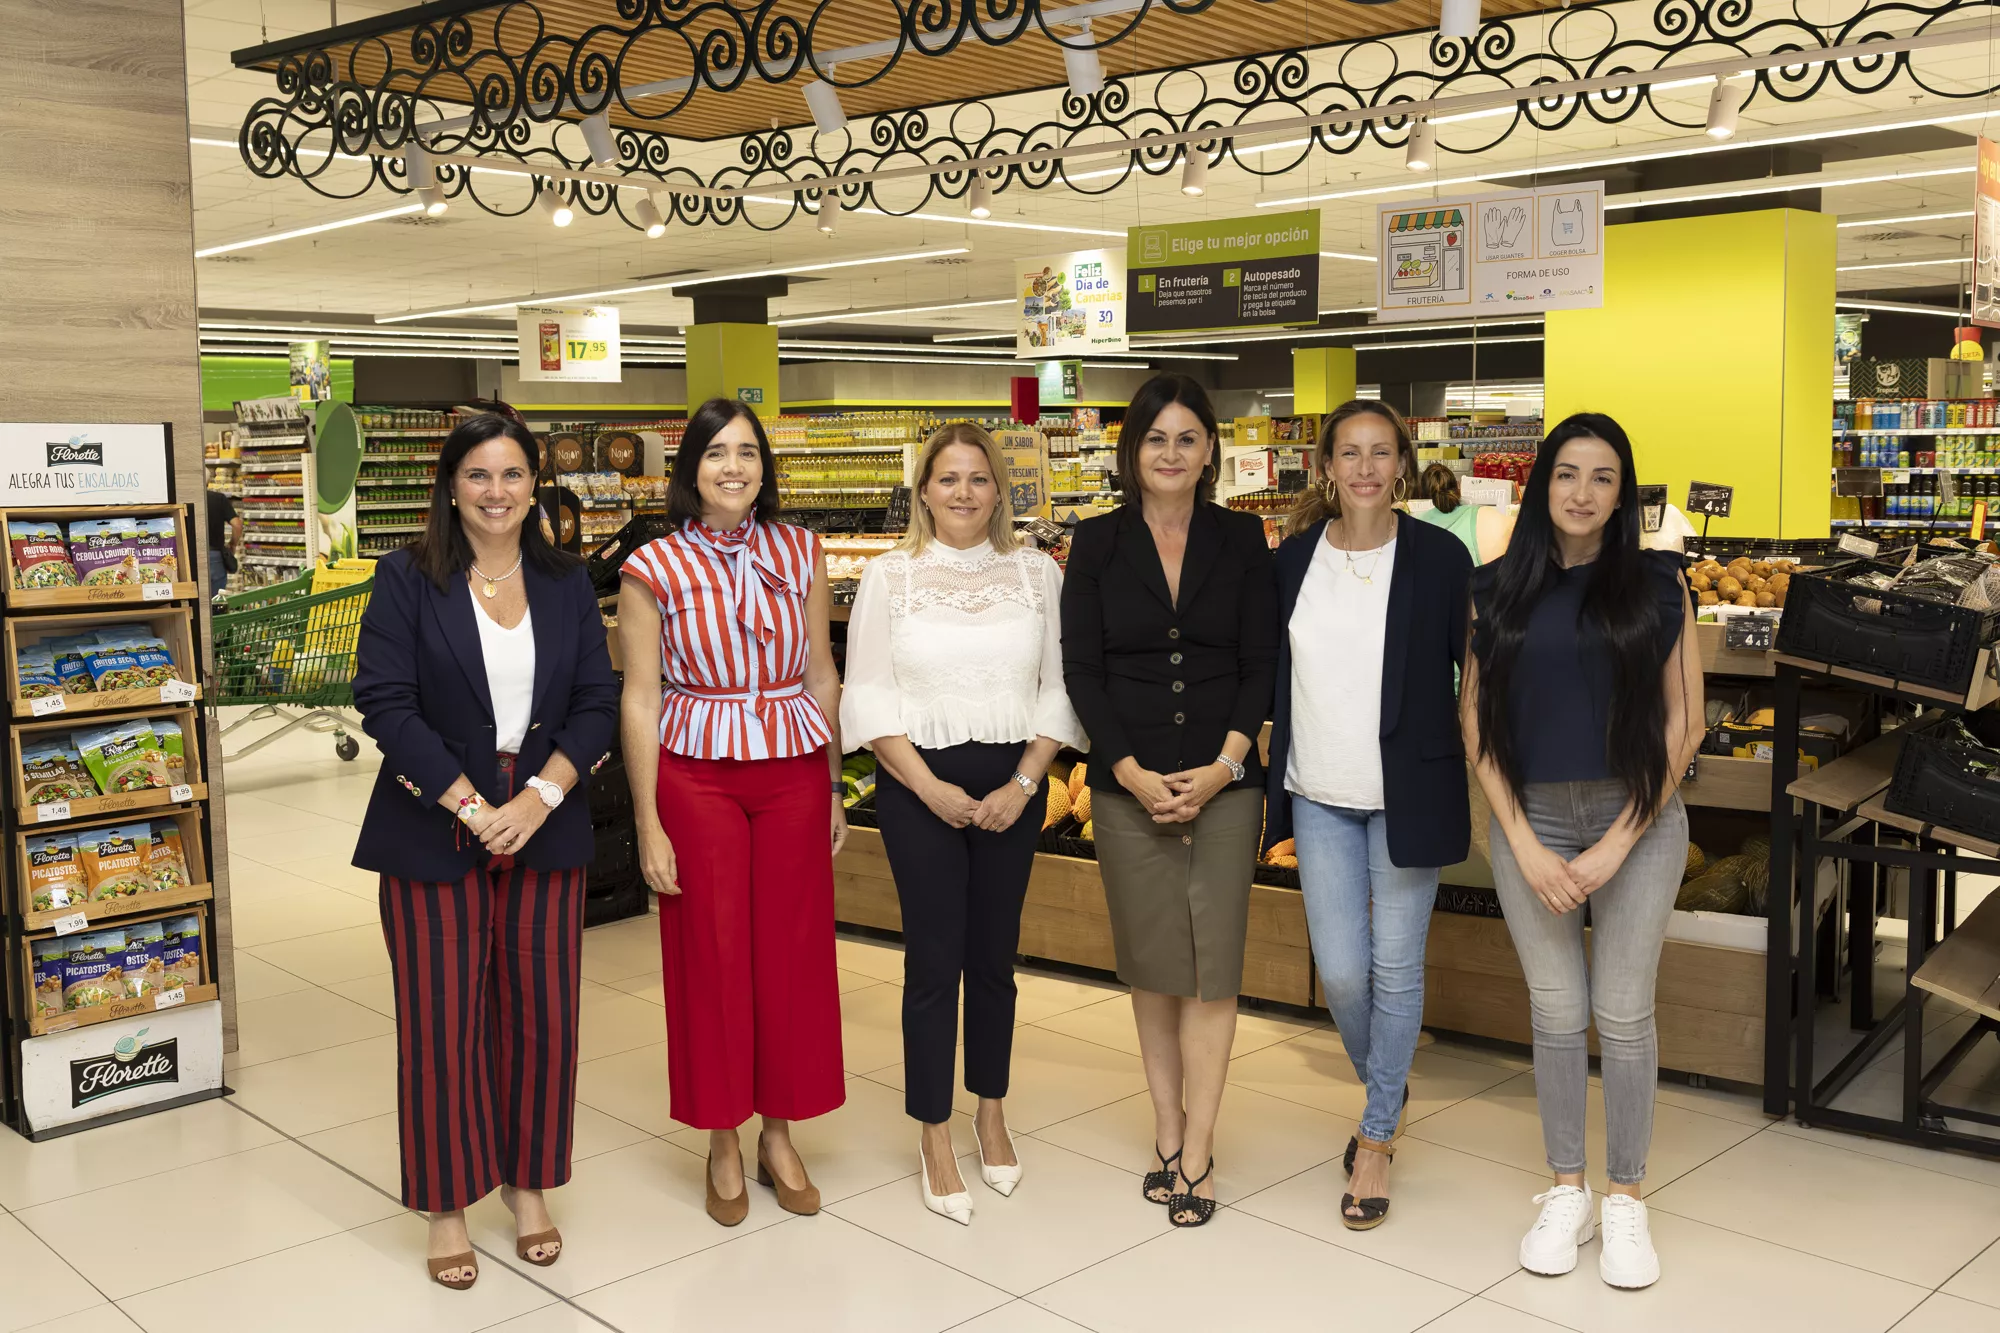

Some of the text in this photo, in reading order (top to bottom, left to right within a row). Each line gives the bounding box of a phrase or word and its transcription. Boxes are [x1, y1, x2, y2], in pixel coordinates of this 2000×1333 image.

[1172, 226, 1309, 255] Elige tu mejor opción
[1500, 252, 1525, 260] GUANTES
[1075, 263, 1101, 278] Feliz
[1244, 268, 1301, 283] Autopesado
[1506, 267, 1570, 280] FORMA DE USO
[1159, 275, 1209, 288] En frutería
[1229, 272, 1235, 283] 2
[1076, 277, 1109, 291] Día de
[1144, 279, 1150, 289] 1
[1244, 281, 1294, 293] Marca el número
[1075, 290, 1122, 304] Canarias
[1159, 288, 1212, 299] Deja que nosotros
[1243, 289, 1307, 301] de tecla del producto
[1407, 294, 1445, 305] FRUTERÍA
[1159, 298, 1186, 308] pesemos
[1187, 298, 1198, 307] por
[1247, 301, 1263, 310] pega
[1264, 300, 1270, 308] la
[1271, 299, 1296, 309] etiqueta
[1098, 310, 1113, 323] 30
[1243, 308, 1276, 318] en la bolsa
[1953, 351, 1981, 360] OERTA
[1877, 386, 1899, 394] Tropical
[1004, 436, 1034, 448] UN SABOR
[51, 446, 100, 462] Florette
[1008, 468, 1039, 477] FRESCANTE
[9, 472, 140, 490] ALEGRA TUS ENSALADAS
[1704, 500, 1713, 512] 4
[138, 536, 159, 546] orette
[23, 545, 49, 556] FRUTOS
[75, 550, 104, 562] CEBOLLA
[88, 588, 125, 601] Florette
[155, 589, 170, 598] 1,49
[1745, 633, 1754, 646] 4
[93, 657, 117, 669] FRUTOS
[178, 688, 193, 697] 1,99
[45, 699, 61, 708] 1,45
[93, 694, 130, 708] Florette
[103, 747, 146, 768] PICATOSTES
[23, 773, 31, 782] 5
[30, 766, 66, 780] SEMILLAS
[174, 787, 190, 797] 1,99
[98, 797, 136, 811] Florette
[51, 806, 67, 815] 1,49
[99, 842, 134, 855] Florette
[33, 852, 71, 864] Florette
[98, 856, 141, 871] PICATOSTES
[31, 864, 78, 880] PICATOSTES
[104, 900, 142, 915] Florette
[68, 918, 84, 929] 1,99
[71, 952, 105, 962] Florette
[65, 963, 111, 977] PICATOSTES
[168, 991, 183, 1001] 1,45
[109, 1002, 146, 1018] Florette
[79, 1053, 173, 1094] Florette
